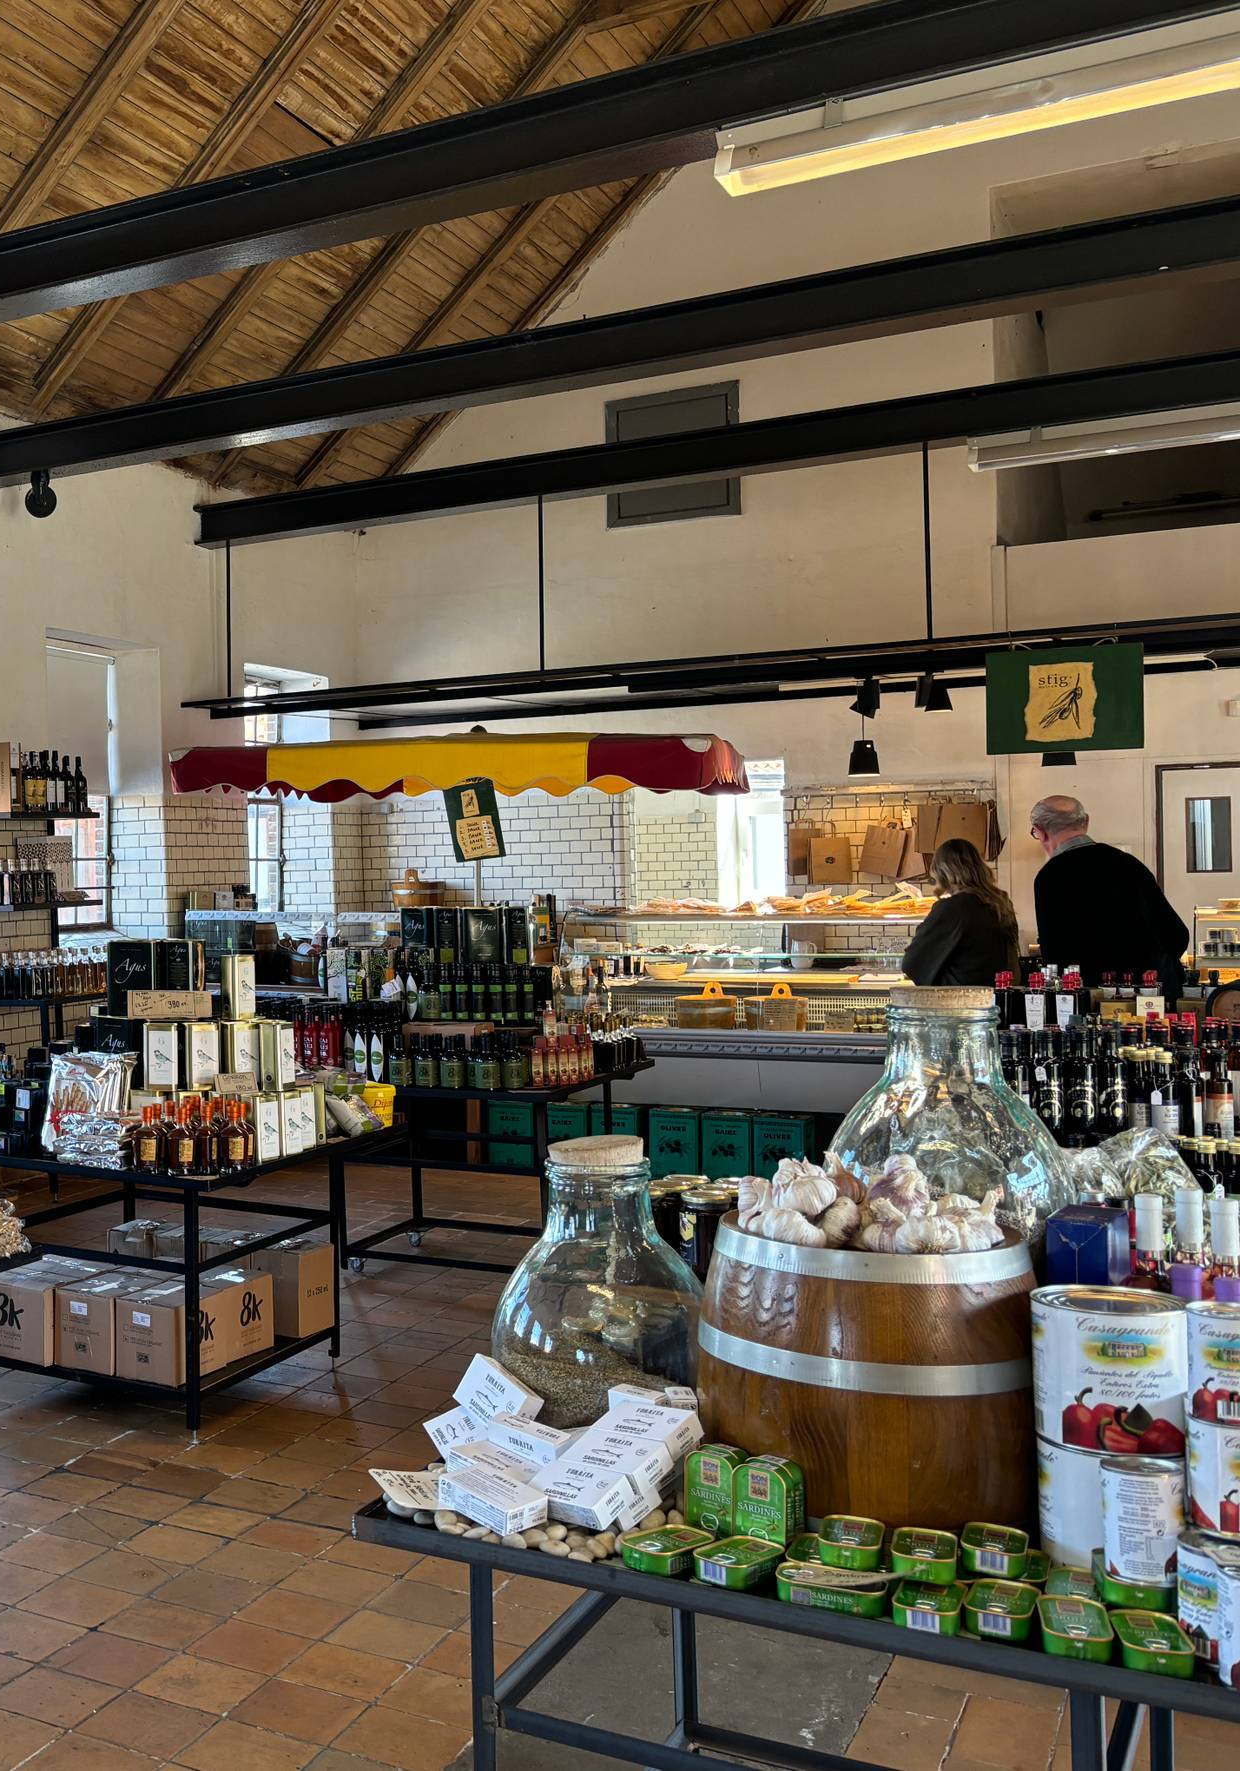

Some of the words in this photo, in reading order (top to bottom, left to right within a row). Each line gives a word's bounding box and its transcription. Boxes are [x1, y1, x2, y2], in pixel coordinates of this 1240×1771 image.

[1038, 673, 1068, 688] stig
[115, 957, 146, 984] Agus
[168, 1000, 180, 1009] 380
[101, 1034, 125, 1051] Agus
[240, 1291, 263, 1327] 8k
[1199, 1322, 1240, 1341] Casag
[690, 1488, 732, 1505] SARDINES
[738, 1502, 781, 1519] SARDINES
[811, 1591, 854, 1604] SARDINES
